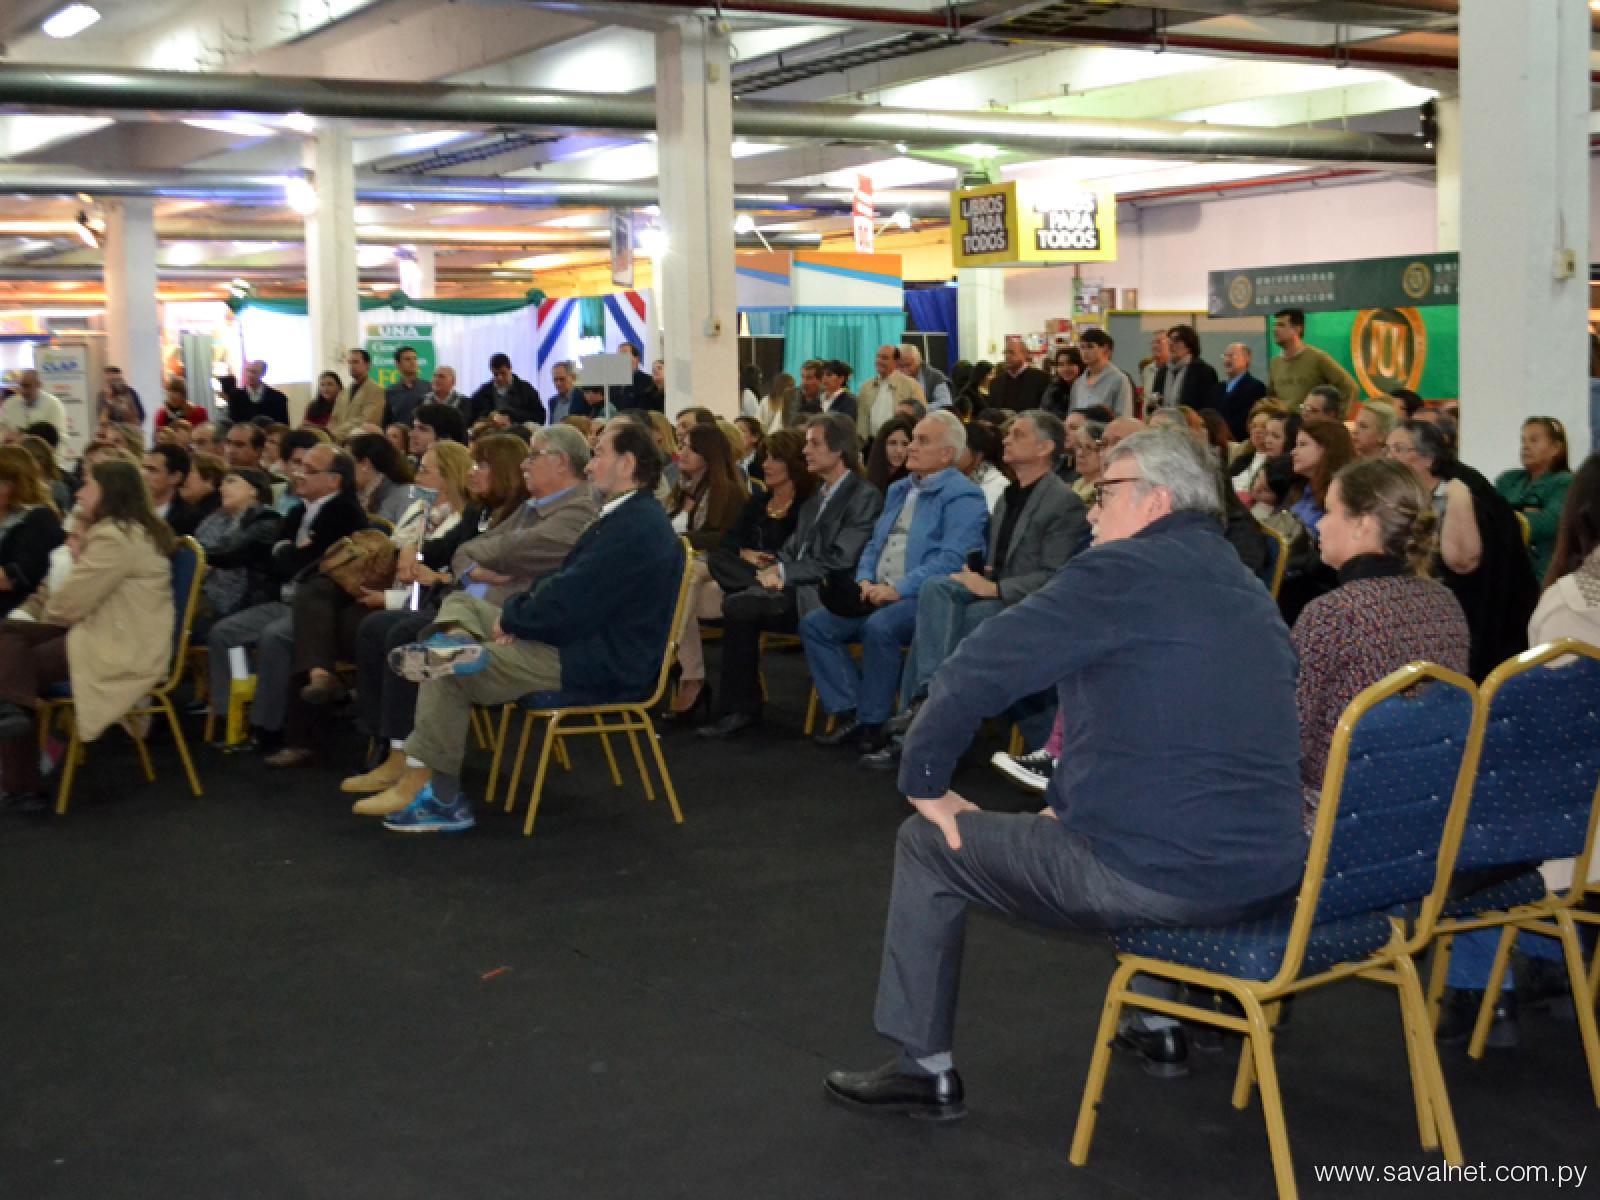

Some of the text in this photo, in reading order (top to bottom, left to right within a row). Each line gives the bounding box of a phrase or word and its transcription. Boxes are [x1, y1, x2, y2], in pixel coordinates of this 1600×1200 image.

[961, 195, 1003, 217] LIBROS
[972, 212, 1003, 234] PARA
[1049, 211, 1093, 229] PARA
[963, 231, 1005, 253] TODOS
[1037, 230, 1096, 248] TODOS
